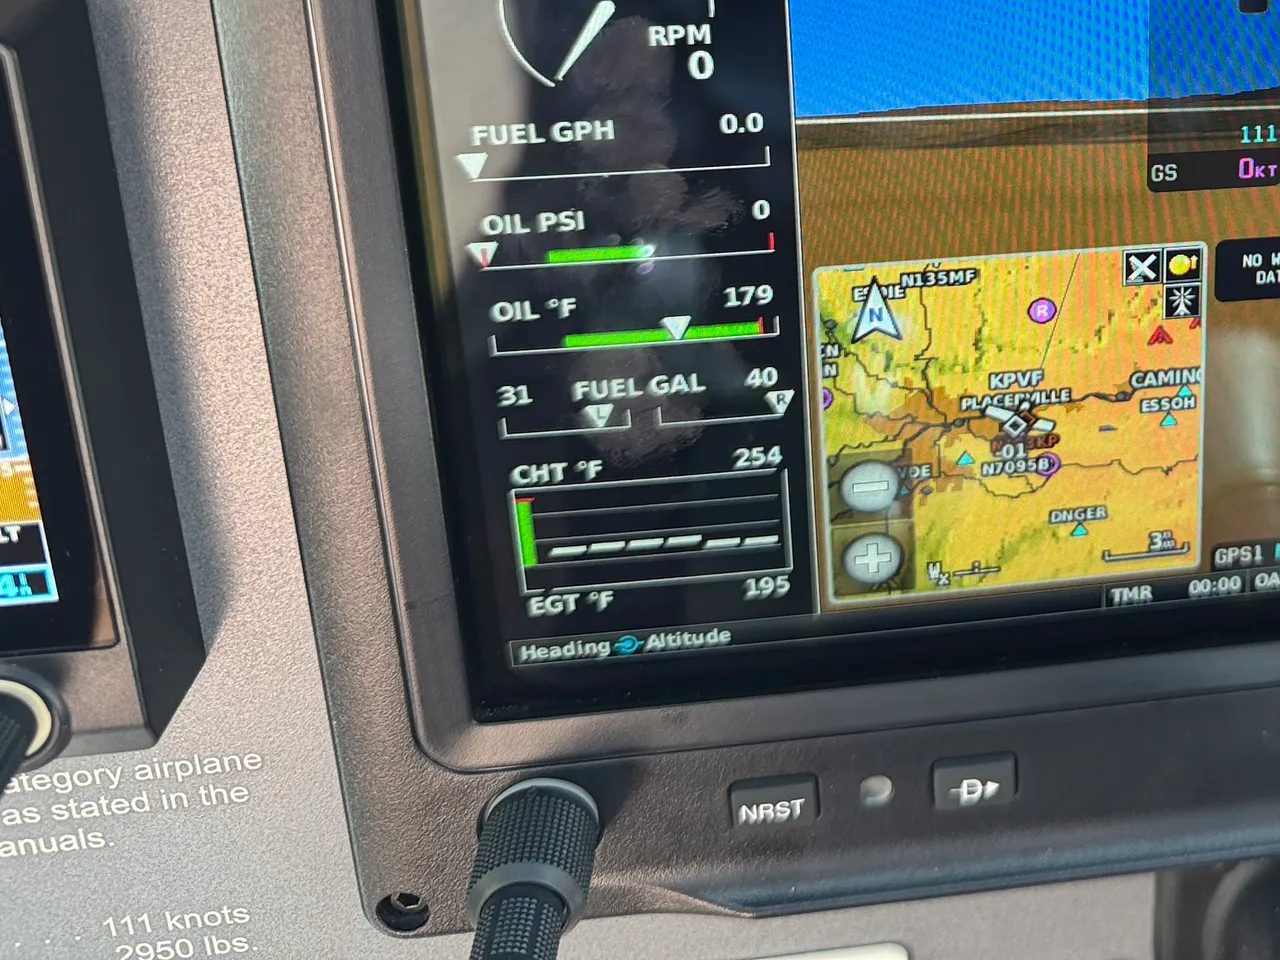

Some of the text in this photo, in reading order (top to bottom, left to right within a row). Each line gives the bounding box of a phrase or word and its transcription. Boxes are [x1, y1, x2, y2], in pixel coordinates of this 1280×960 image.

[649, 24, 711, 46] RPM
[688, 50, 714, 80] 0
[469, 120, 615, 146] FUEL GPH
[719, 113, 764, 134] 0.0
[1240, 125, 1277, 143] 111
[1151, 164, 1178, 182] GS
[752, 199, 770, 220] 0
[480, 210, 585, 236] OIL PSI
[1242, 253, 1262, 268] NO
[901, 269, 976, 287] N135MF
[722, 284, 774, 308] 179
[489, 300, 541, 322] OIL
[869, 308, 883, 322] N
[571, 373, 707, 401] FUEL GAL
[744, 367, 778, 388] 40
[990, 370, 1043, 389] KPVF
[497, 385, 534, 406] 31
[1141, 396, 1196, 412] ESSOH
[731, 445, 783, 470] 254
[982, 458, 1050, 476] N7095B
[509, 462, 568, 486] CHT
[1051, 506, 1106, 522] DNGER
[1214, 545, 1263, 565] GPS1
[742, 575, 791, 600] 195
[1110, 585, 1153, 605] TMR
[1188, 576, 1241, 597] 00:00
[527, 593, 580, 617] EGT
[519, 639, 611, 662] Heading
[643, 628, 732, 651] Altitude
[135, 753, 262, 783] airplane
[2, 784, 249, 825] as stated in the
[738, 799, 805, 825] NRST
[0, 829, 115, 858] anuals.
[103, 905, 250, 937] 111 knots
[116, 936, 258, 960] 2950 lbs.
